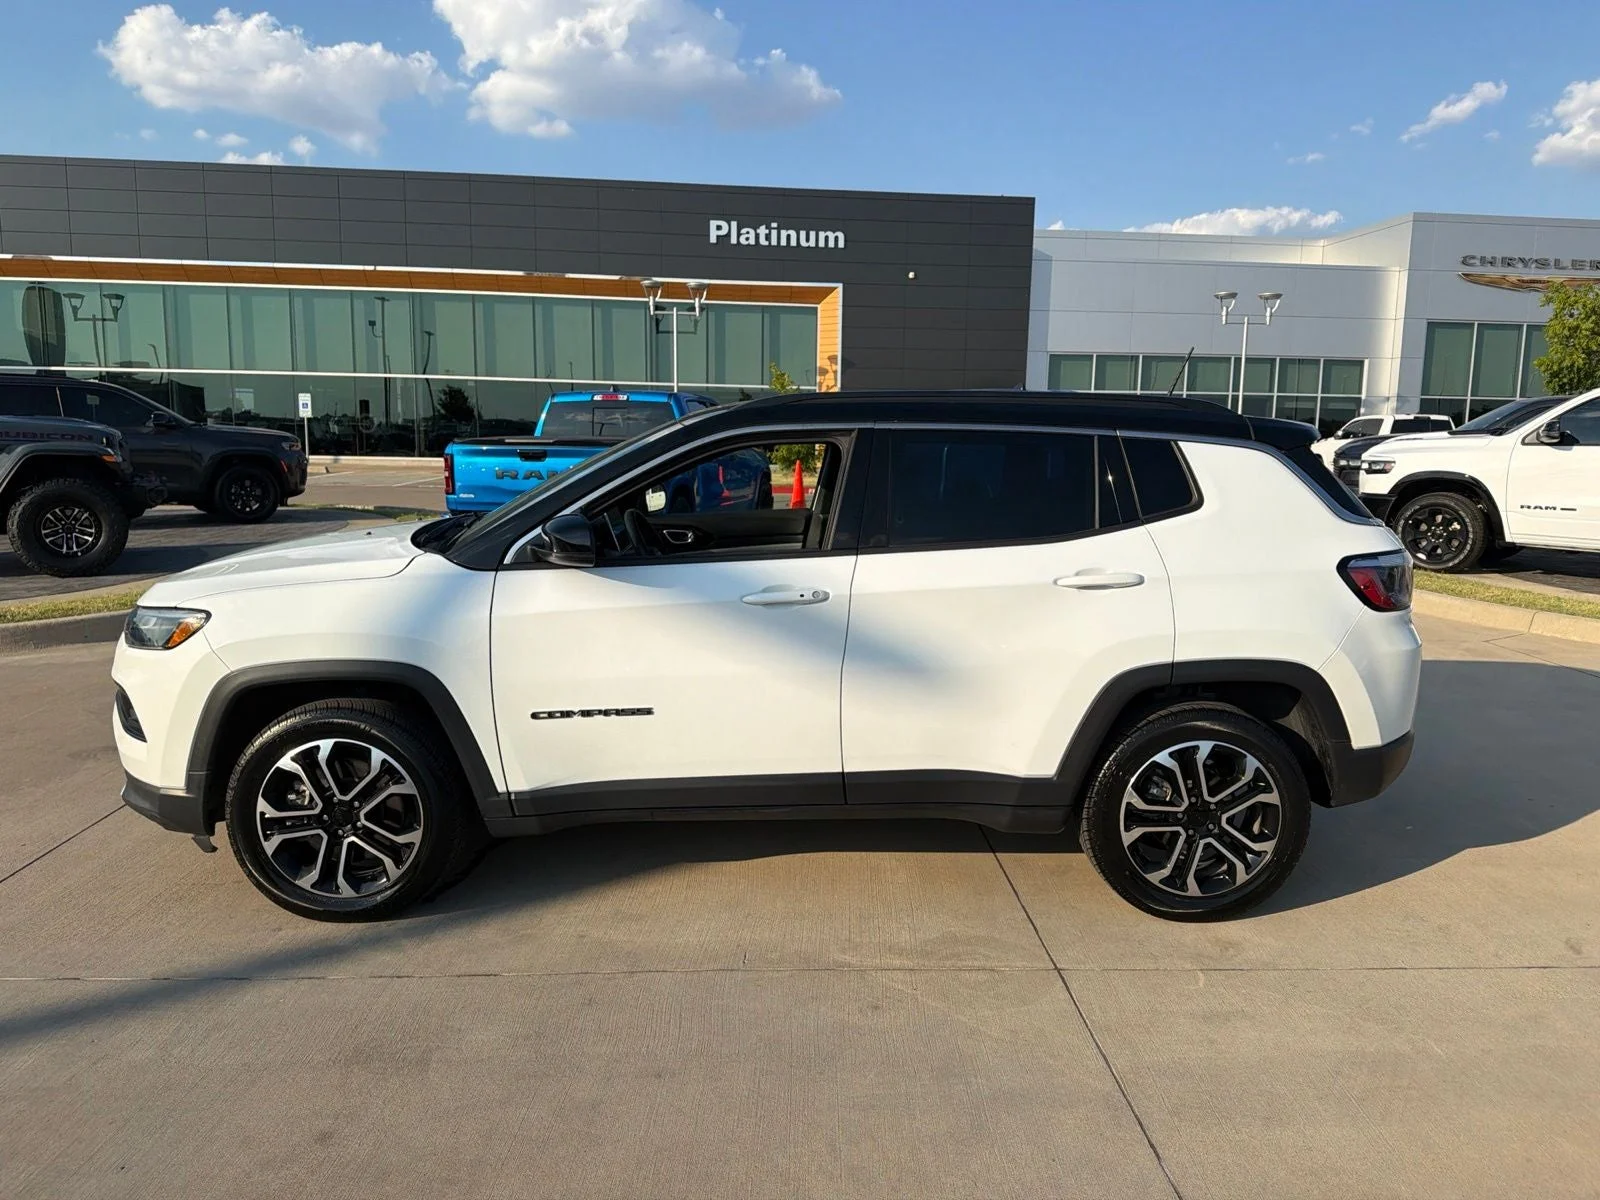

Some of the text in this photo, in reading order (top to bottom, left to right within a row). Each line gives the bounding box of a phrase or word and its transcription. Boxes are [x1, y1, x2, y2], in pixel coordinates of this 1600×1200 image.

[709, 219, 845, 248] Platinum
[1460, 254, 1600, 271] CHRYSLER
[0, 431, 94, 440] UBICON
[530, 707, 654, 720] COMPASS
